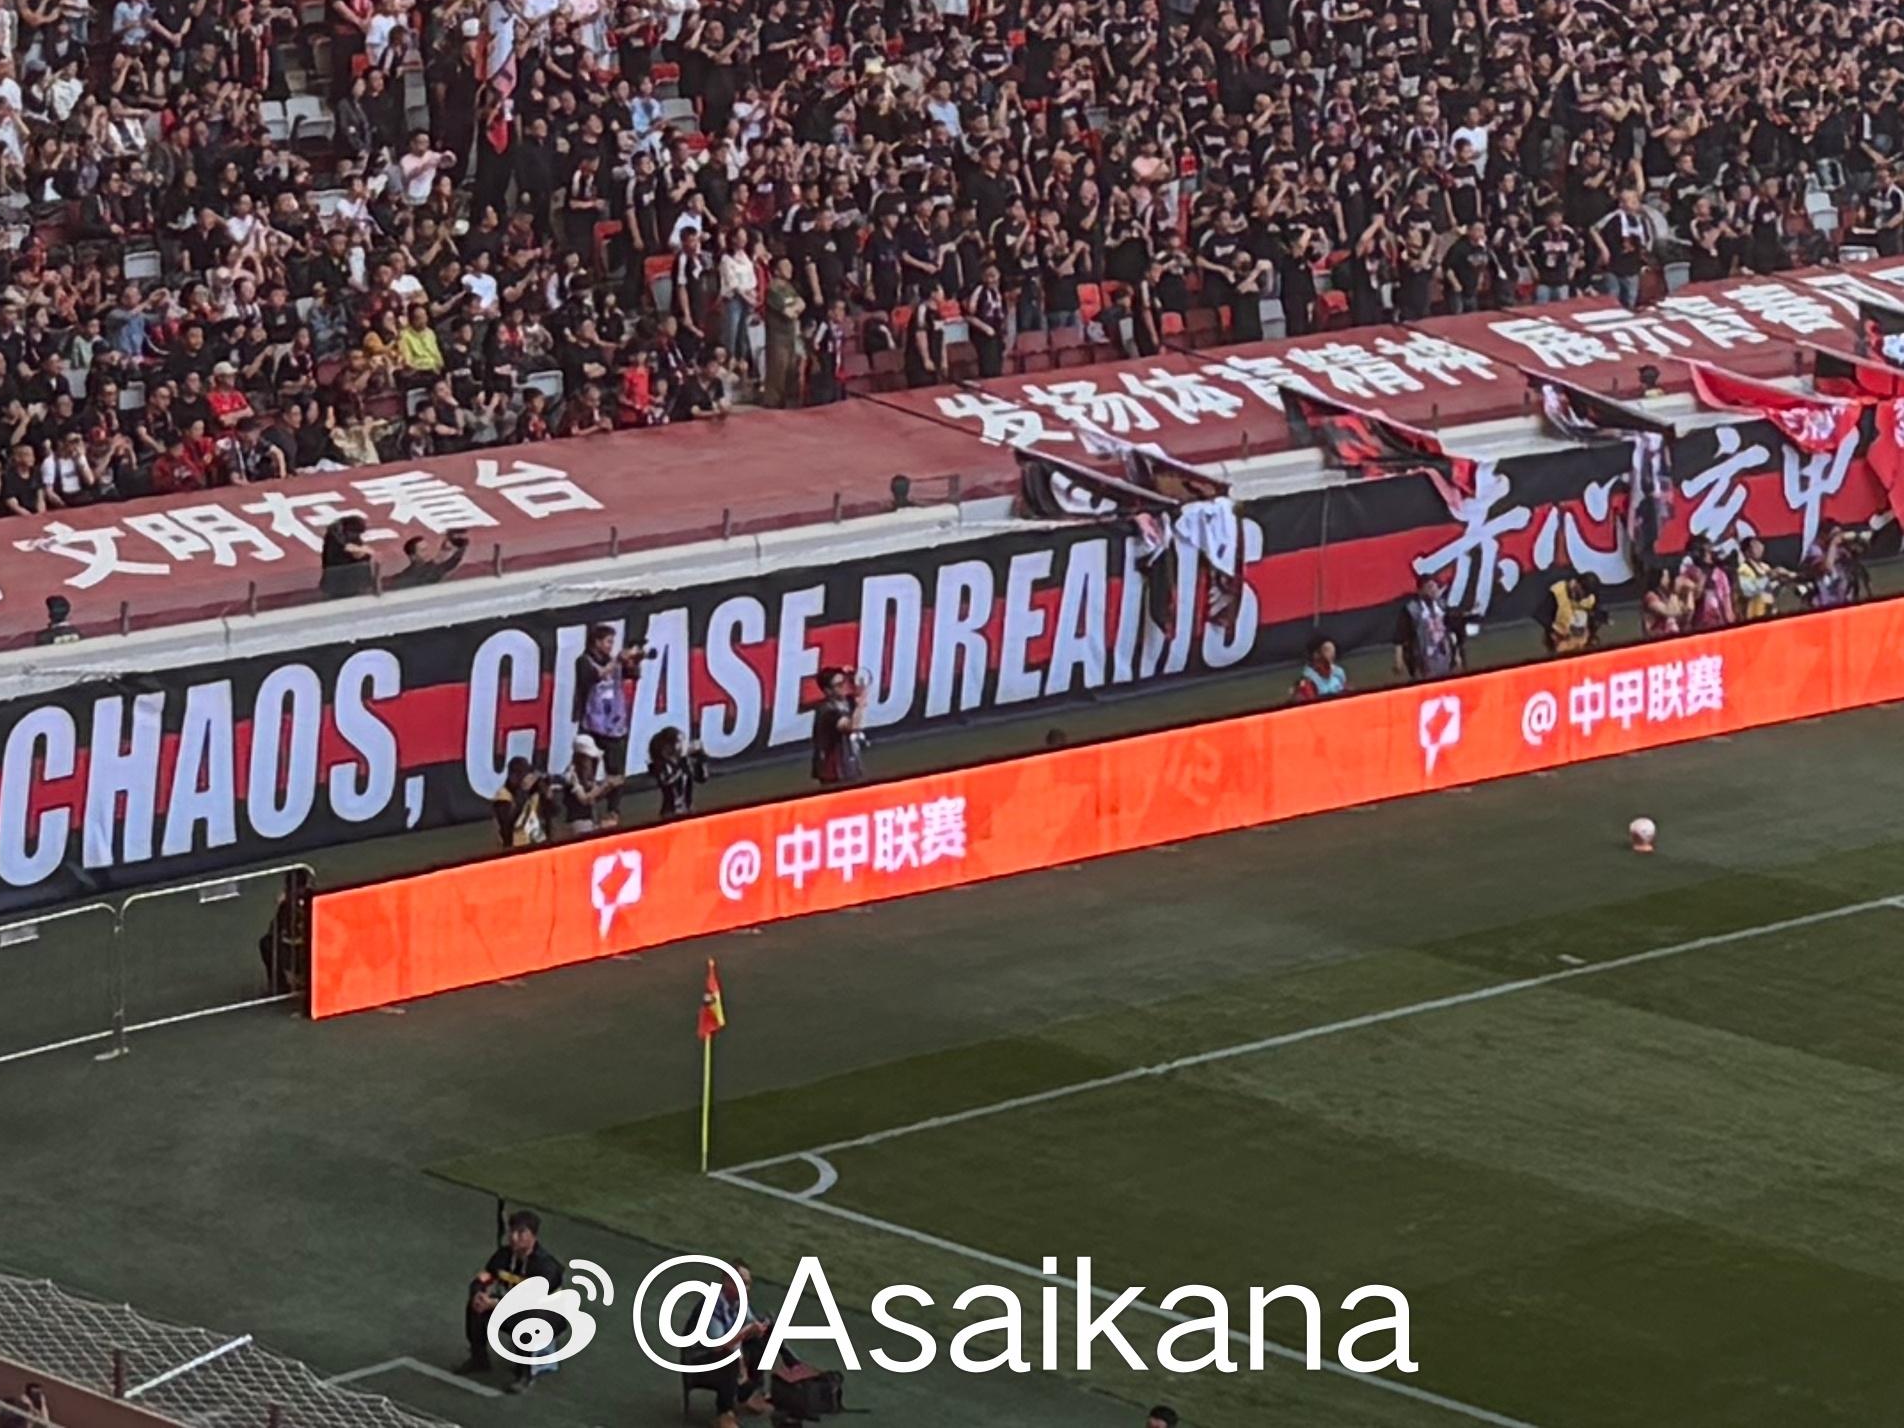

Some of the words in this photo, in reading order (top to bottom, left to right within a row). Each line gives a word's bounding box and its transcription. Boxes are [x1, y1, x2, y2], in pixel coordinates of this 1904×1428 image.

[934, 330, 1498, 447] 发扬体育精神
[13, 457, 605, 590] 文明在看台
